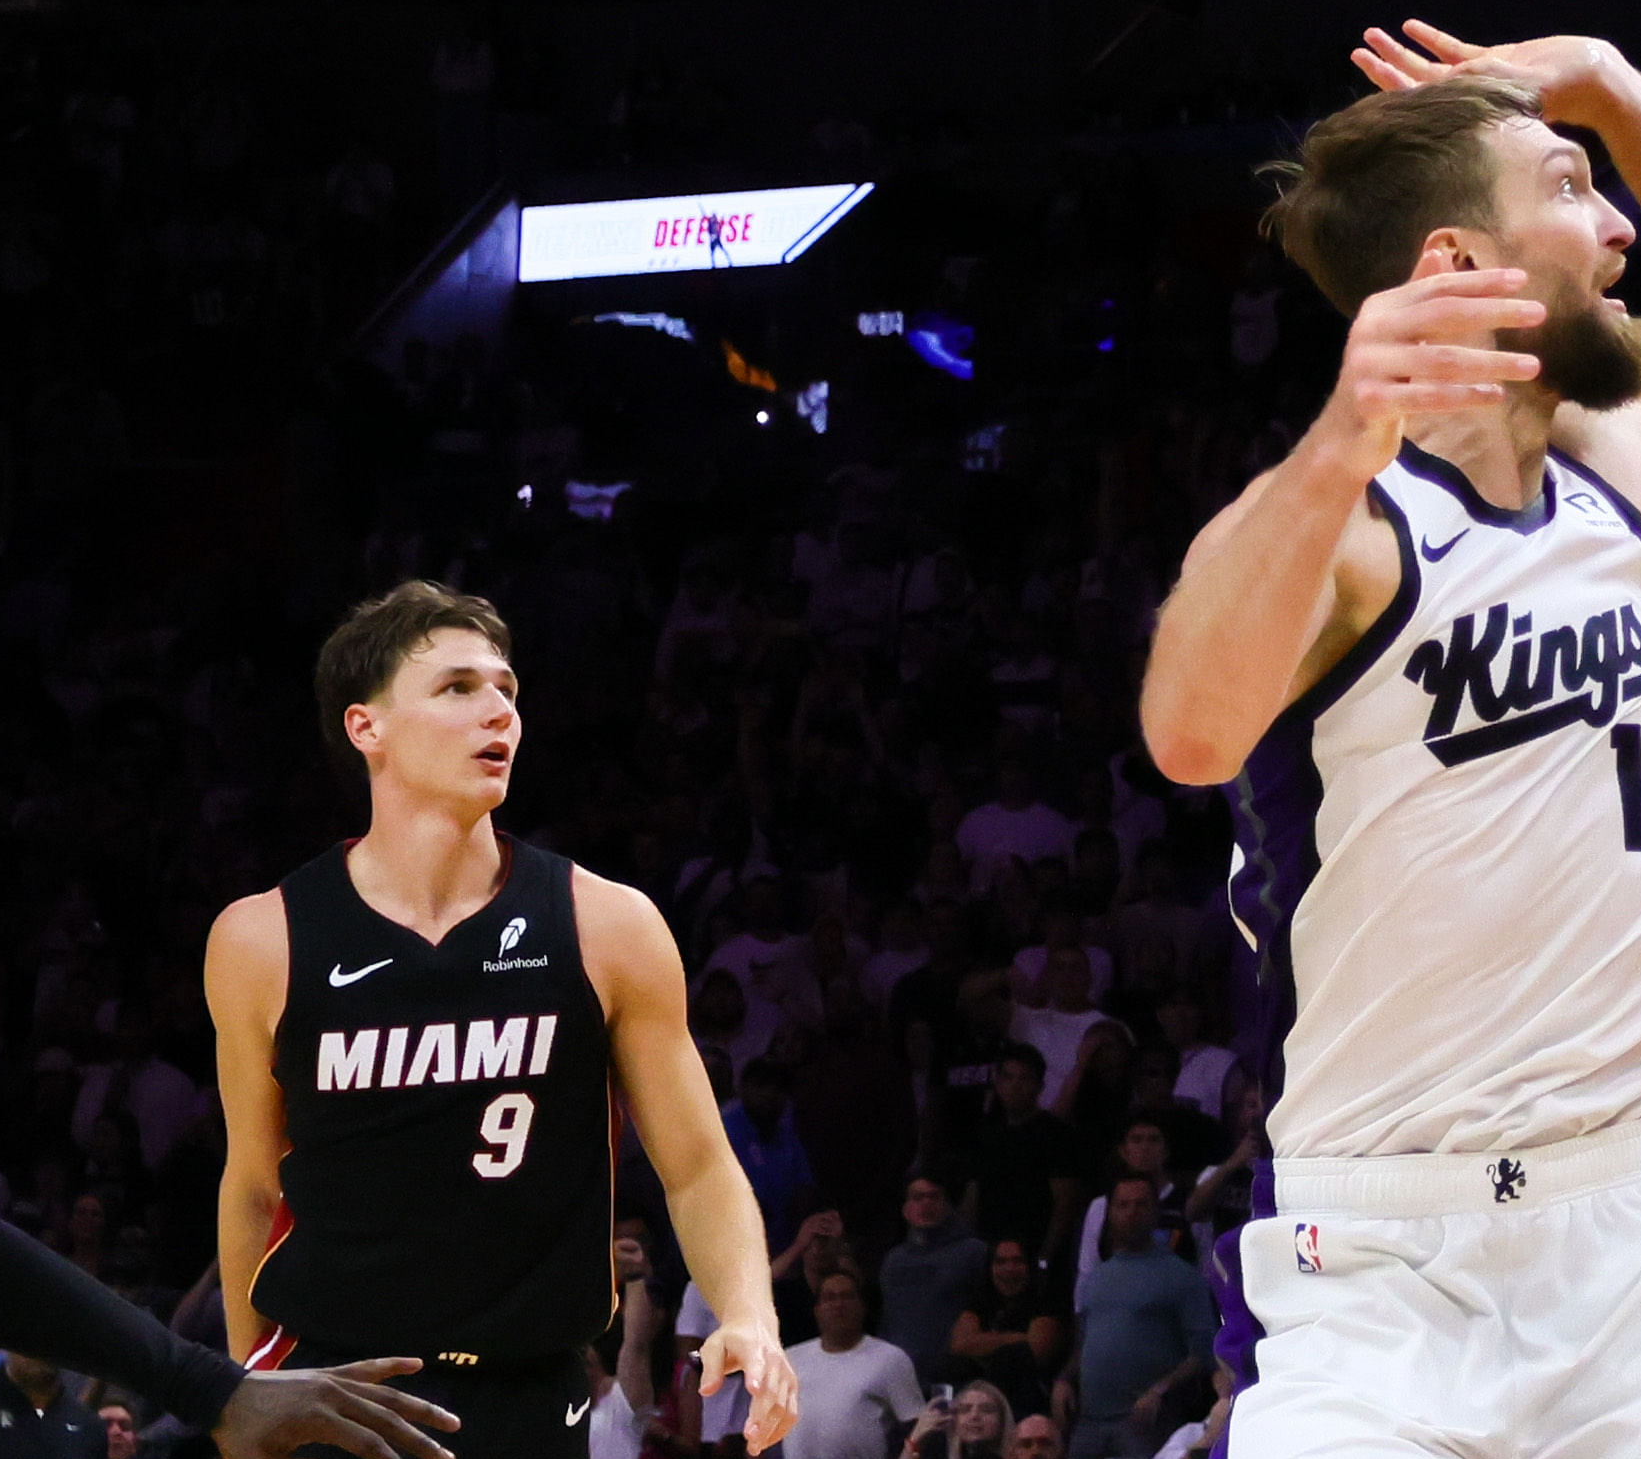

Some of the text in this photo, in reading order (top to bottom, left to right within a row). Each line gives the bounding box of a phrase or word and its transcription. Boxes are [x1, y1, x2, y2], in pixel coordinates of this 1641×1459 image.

[482, 954, 549, 974] Robinhood
[316, 1014, 558, 1091] MIAMI
[472, 1092, 535, 1179] 9
